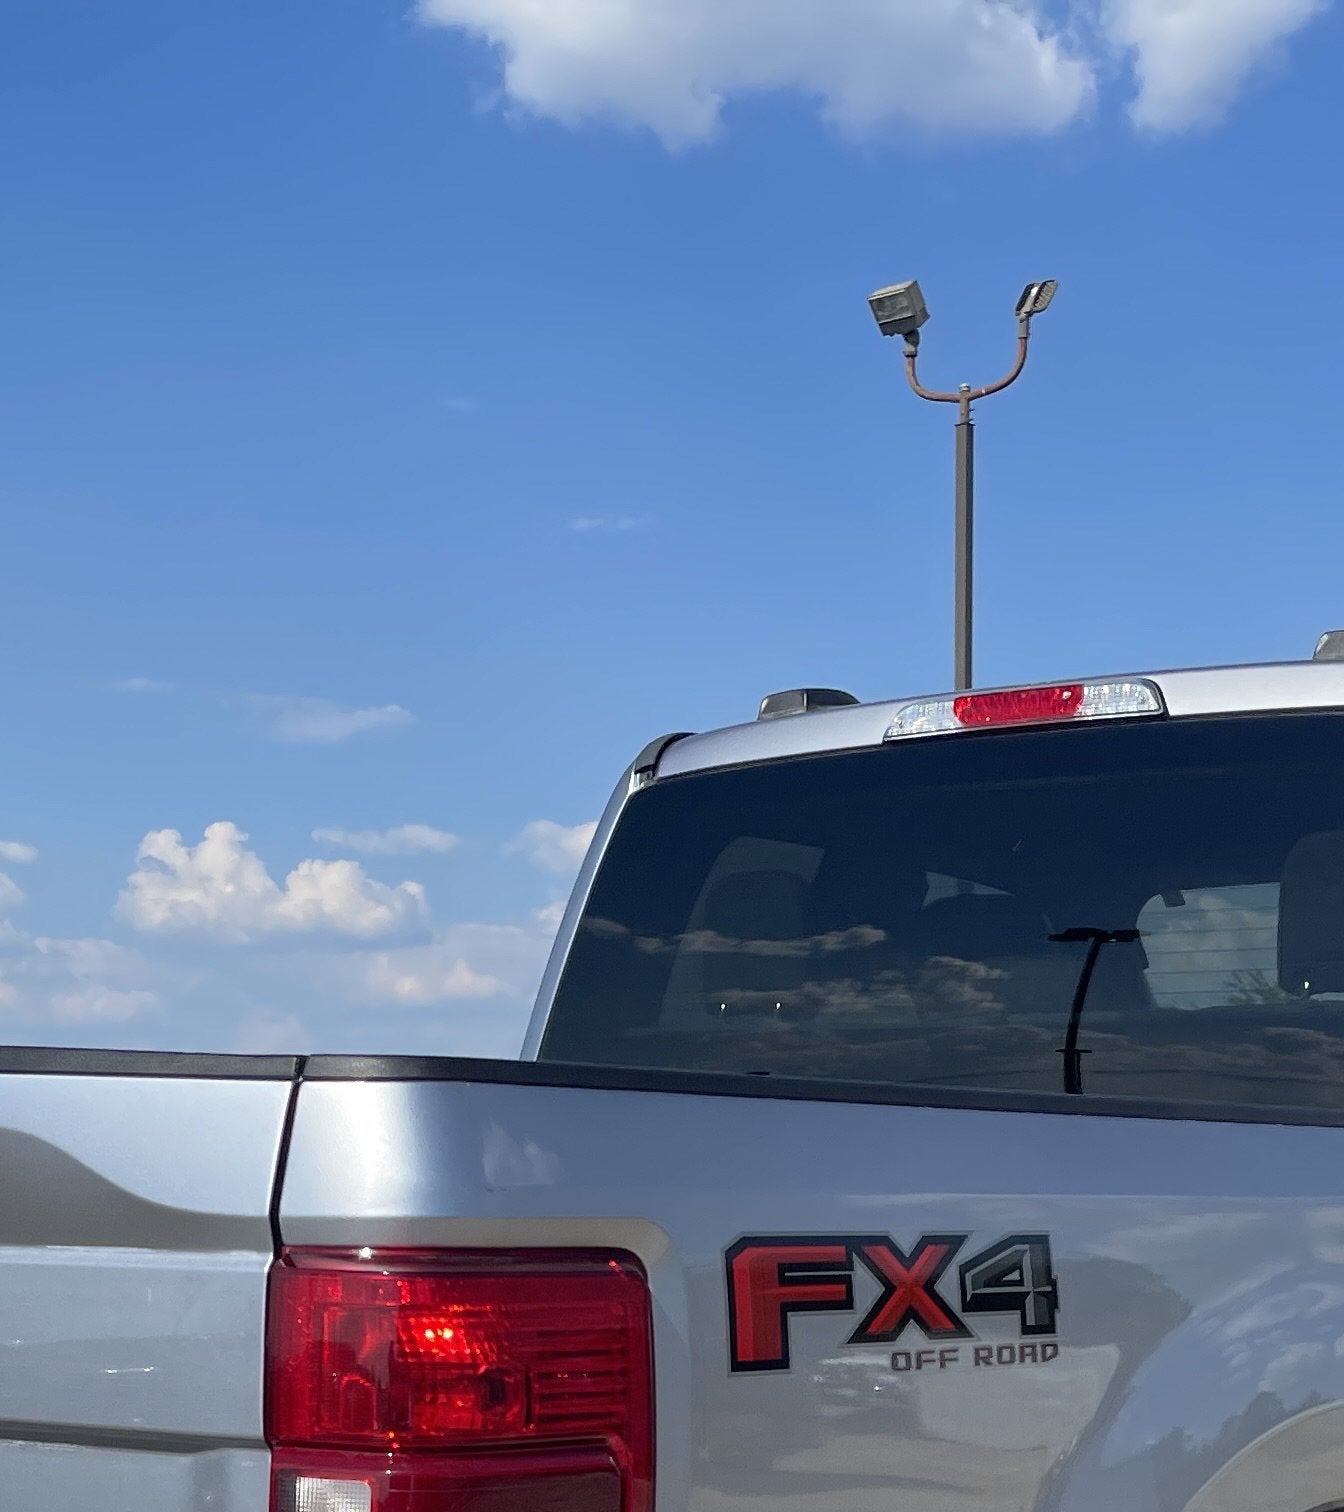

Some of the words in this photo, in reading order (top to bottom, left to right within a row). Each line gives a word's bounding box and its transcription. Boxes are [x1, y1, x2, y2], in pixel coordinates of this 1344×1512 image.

[723, 1232, 1059, 1374] FX4
[890, 1349, 959, 1371] OFF
[973, 1343, 1059, 1367] ROAD
